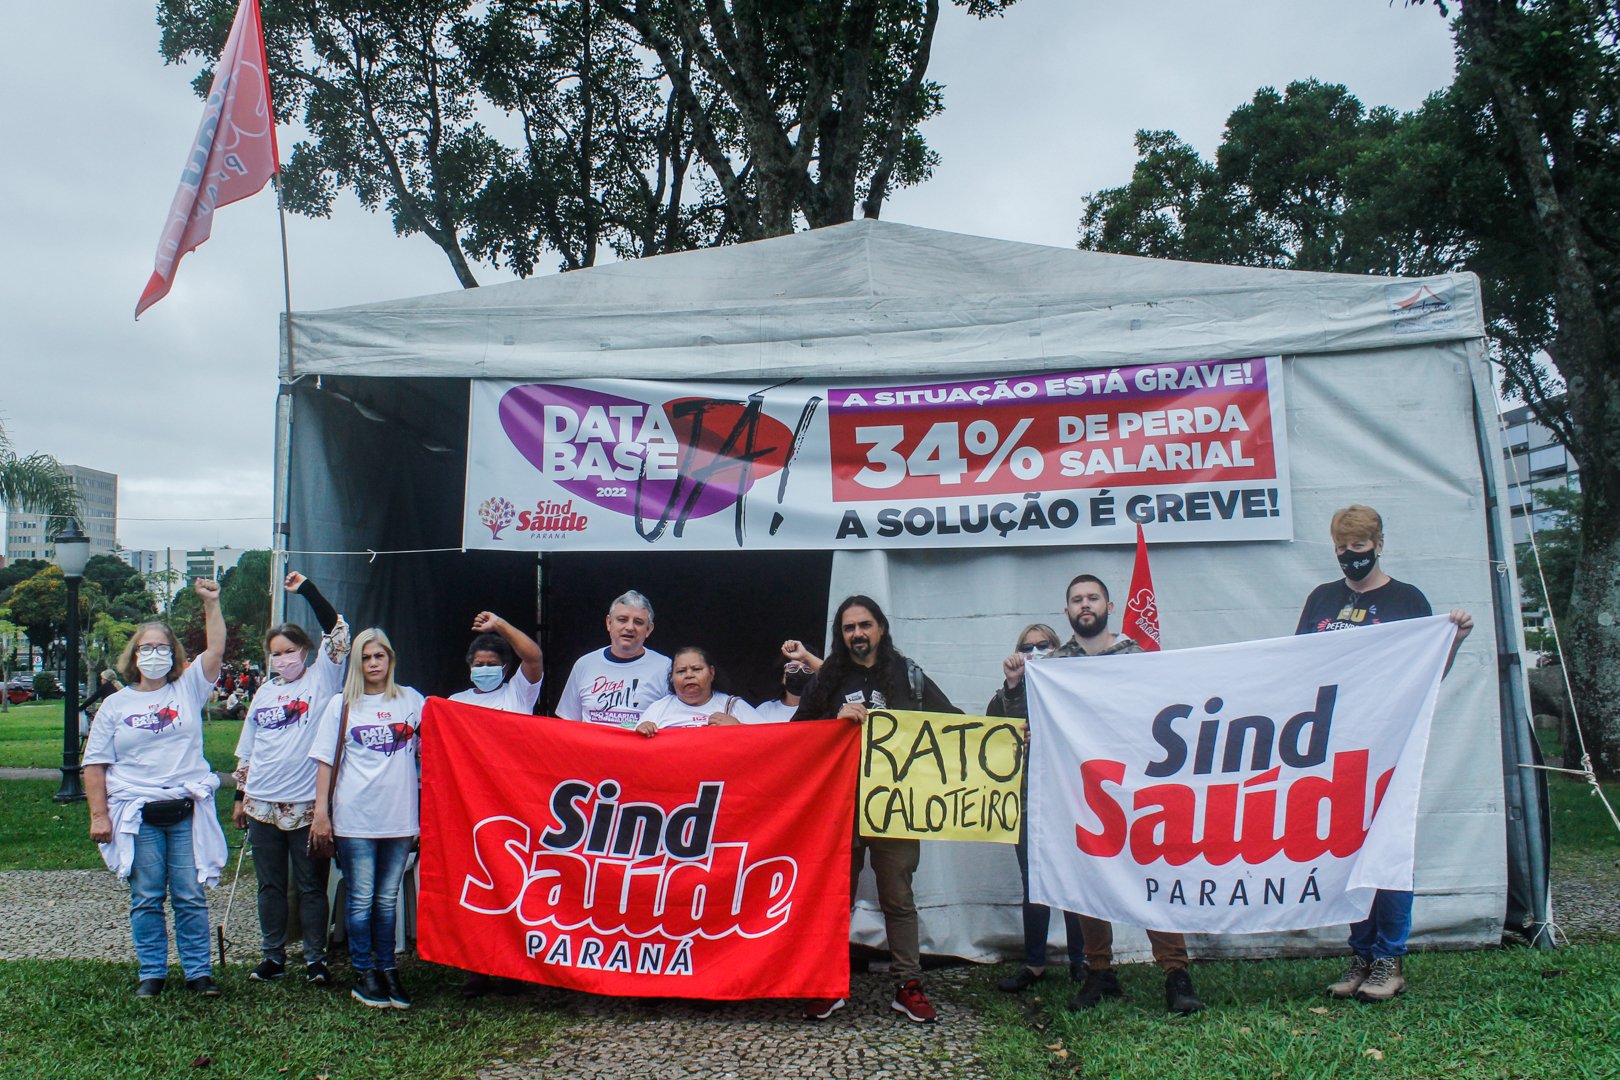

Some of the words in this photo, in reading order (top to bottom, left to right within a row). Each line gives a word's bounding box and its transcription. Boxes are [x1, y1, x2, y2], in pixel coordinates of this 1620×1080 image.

[842, 393, 869, 407] A
[874, 380, 1038, 405] SITUAÇÃO
[1046, 368, 1128, 397] ESTÁ
[1134, 362, 1254, 391] GRAVE!
[543, 405, 678, 443] DATA
[1058, 414, 1110, 443] DE
[1118, 404, 1249, 439] PERDA
[543, 442, 679, 481] BASE
[853, 418, 1045, 489] 34%
[1060, 440, 1255, 477] SALARIAL
[535, 499, 573, 515] Sind
[596, 487, 627, 497] 2022
[515, 510, 588, 531] Saúde
[835, 509, 868, 540] A
[876, 492, 1079, 538] SOLUÇÃO
[1090, 489, 1115, 527] É
[1125, 487, 1280, 524] GREVE!
[594, 678, 639, 712] SIM!
[359, 726, 393, 738] DATA
[362, 735, 394, 747] BASE
[864, 711, 1025, 785] RATO
[1144, 684, 1338, 778] Sind
[539, 779, 725, 860] Sind
[459, 815, 799, 940] Saúde
[1145, 867, 1322, 907] PARANÁ
[525, 930, 694, 976] PARANÁ
